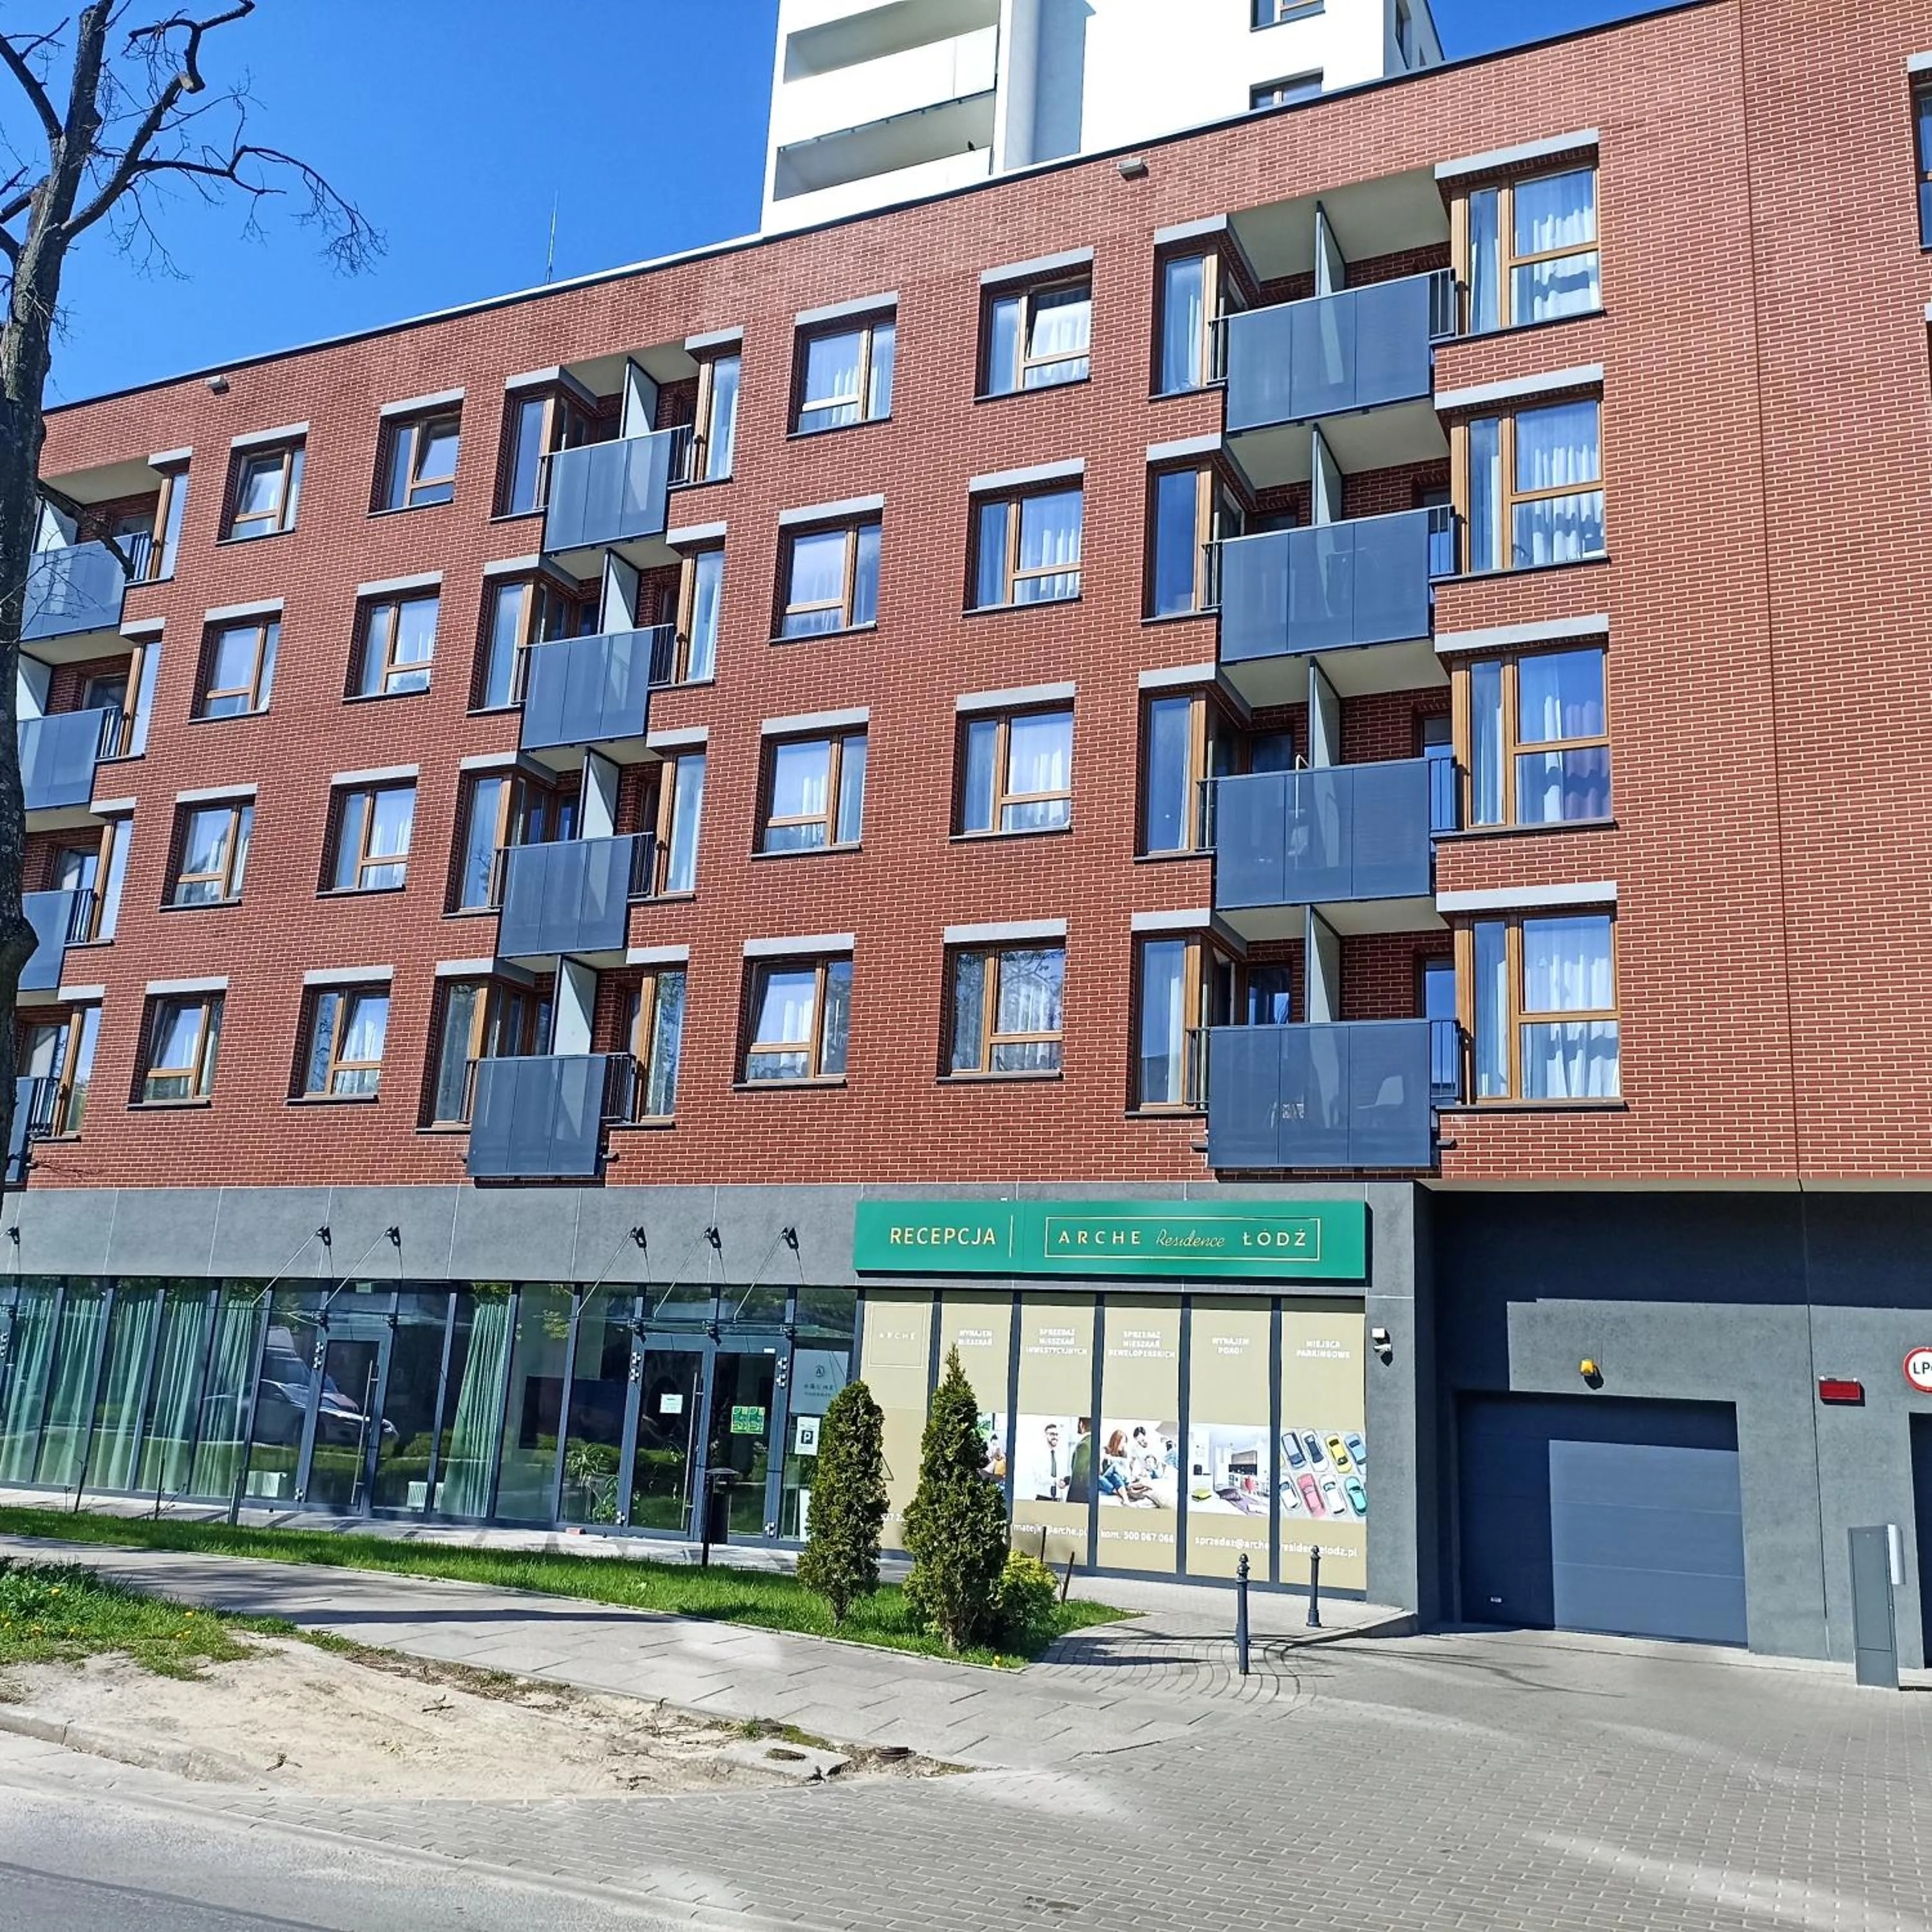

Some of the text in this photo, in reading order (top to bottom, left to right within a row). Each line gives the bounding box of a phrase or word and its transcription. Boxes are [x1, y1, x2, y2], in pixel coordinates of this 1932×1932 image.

[889, 1227, 996, 1245] RECEPCJA
[1058, 1227, 1307, 1248] ARCHE Residence ŁÓDŹ
[878, 1331, 917, 1340] ARCHE
[1913, 1361, 1932, 1375] LP
